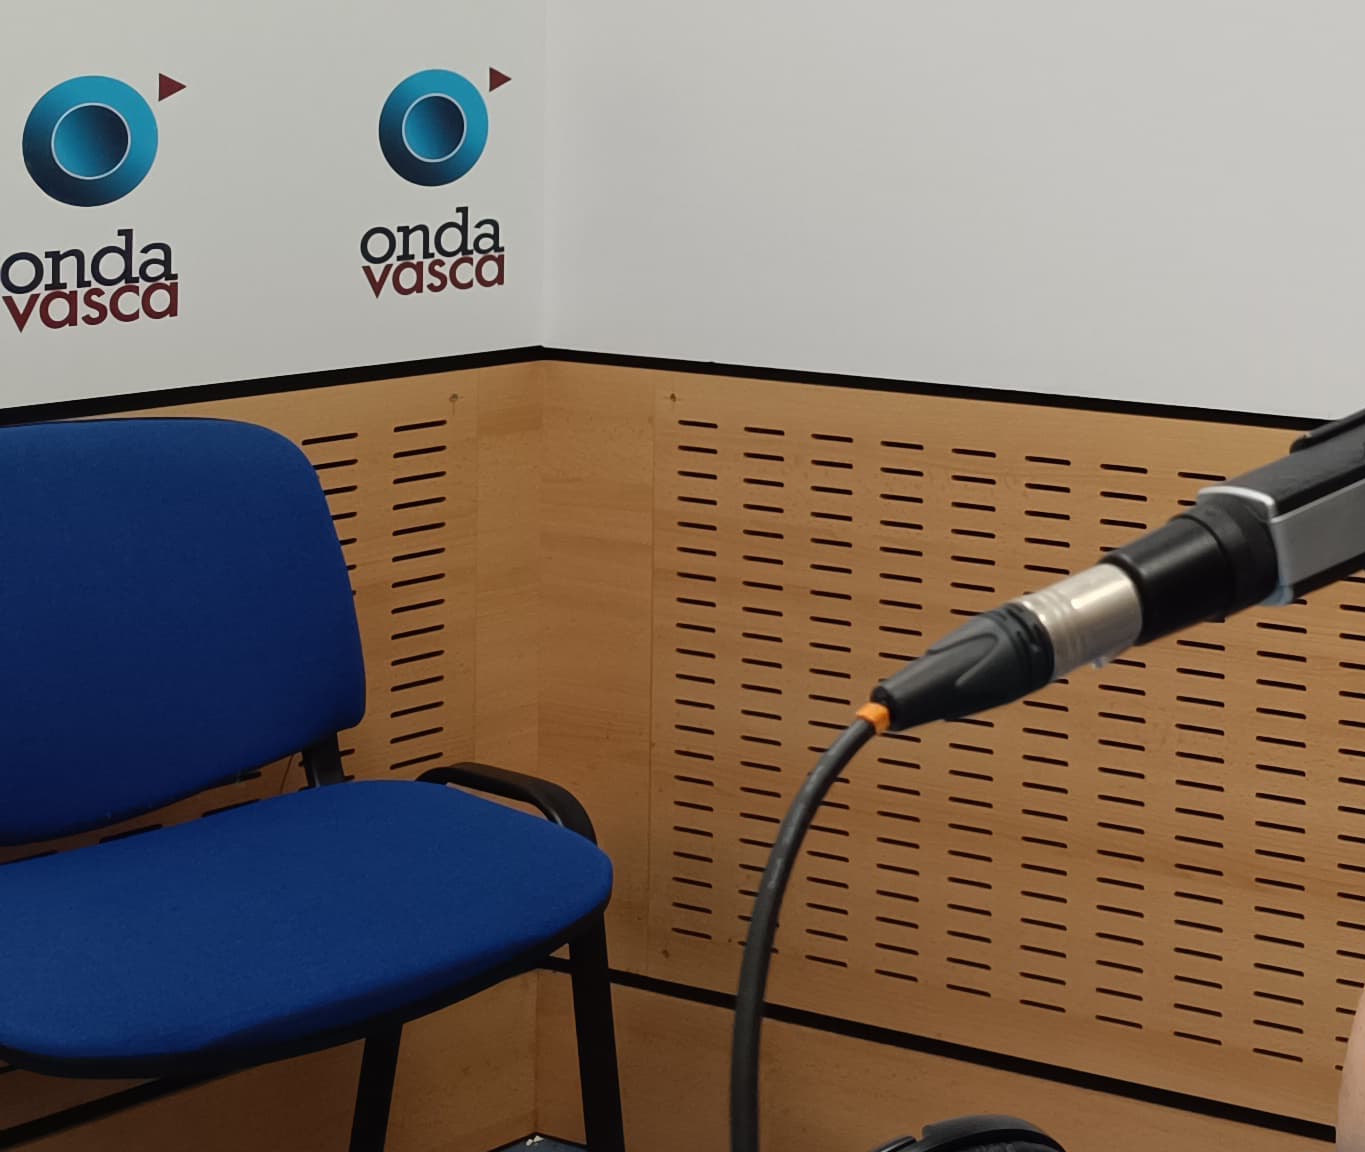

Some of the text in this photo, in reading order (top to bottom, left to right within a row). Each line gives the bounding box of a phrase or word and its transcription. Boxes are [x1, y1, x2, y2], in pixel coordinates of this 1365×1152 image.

[0, 228, 179, 294] onda
[360, 206, 505, 265] onda
[362, 253, 505, 298] vasca
[3, 280, 179, 332] vasca
